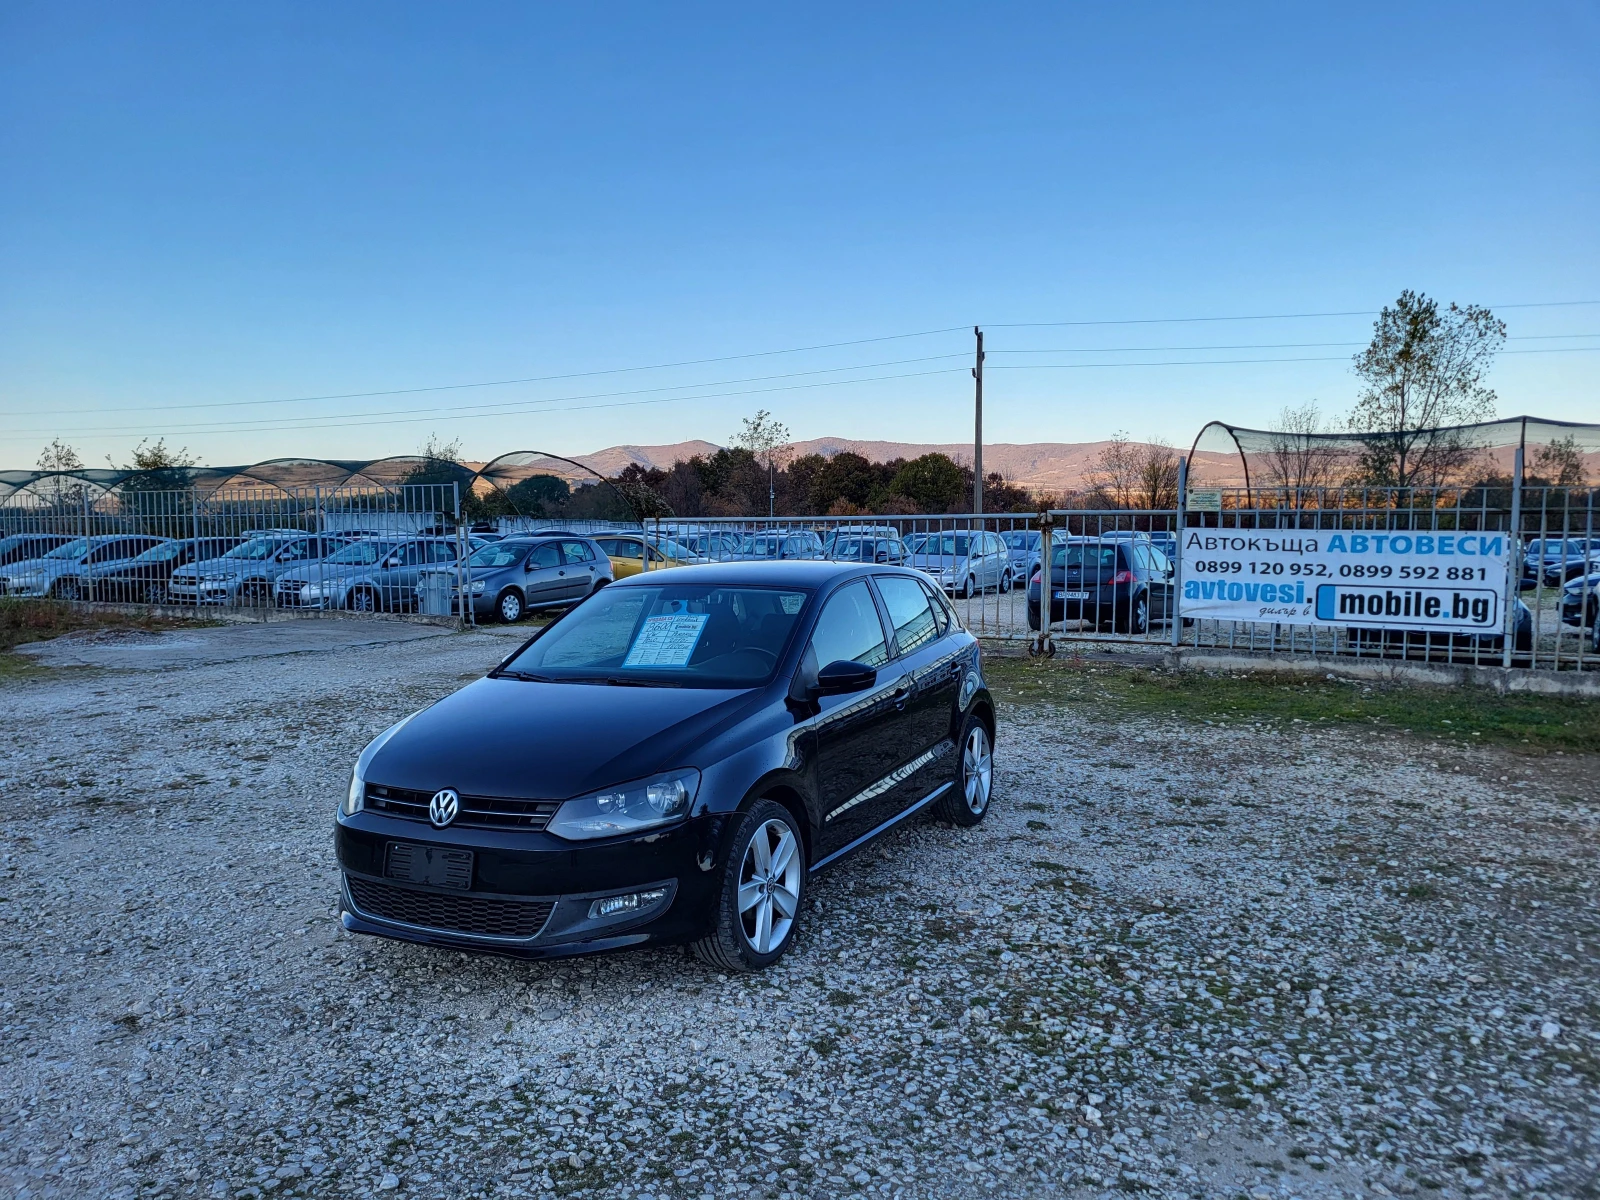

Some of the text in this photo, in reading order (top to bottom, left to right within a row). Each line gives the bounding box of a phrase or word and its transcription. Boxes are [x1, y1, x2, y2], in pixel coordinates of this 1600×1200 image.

[1186, 532, 1502, 556] Автокъща АВТОВЕСИ
[1195, 560, 1486, 581] 0899 120 952, 0899 592 881
[1339, 590, 1489, 623] mobile.bg
[431, 791, 457, 825] VW
